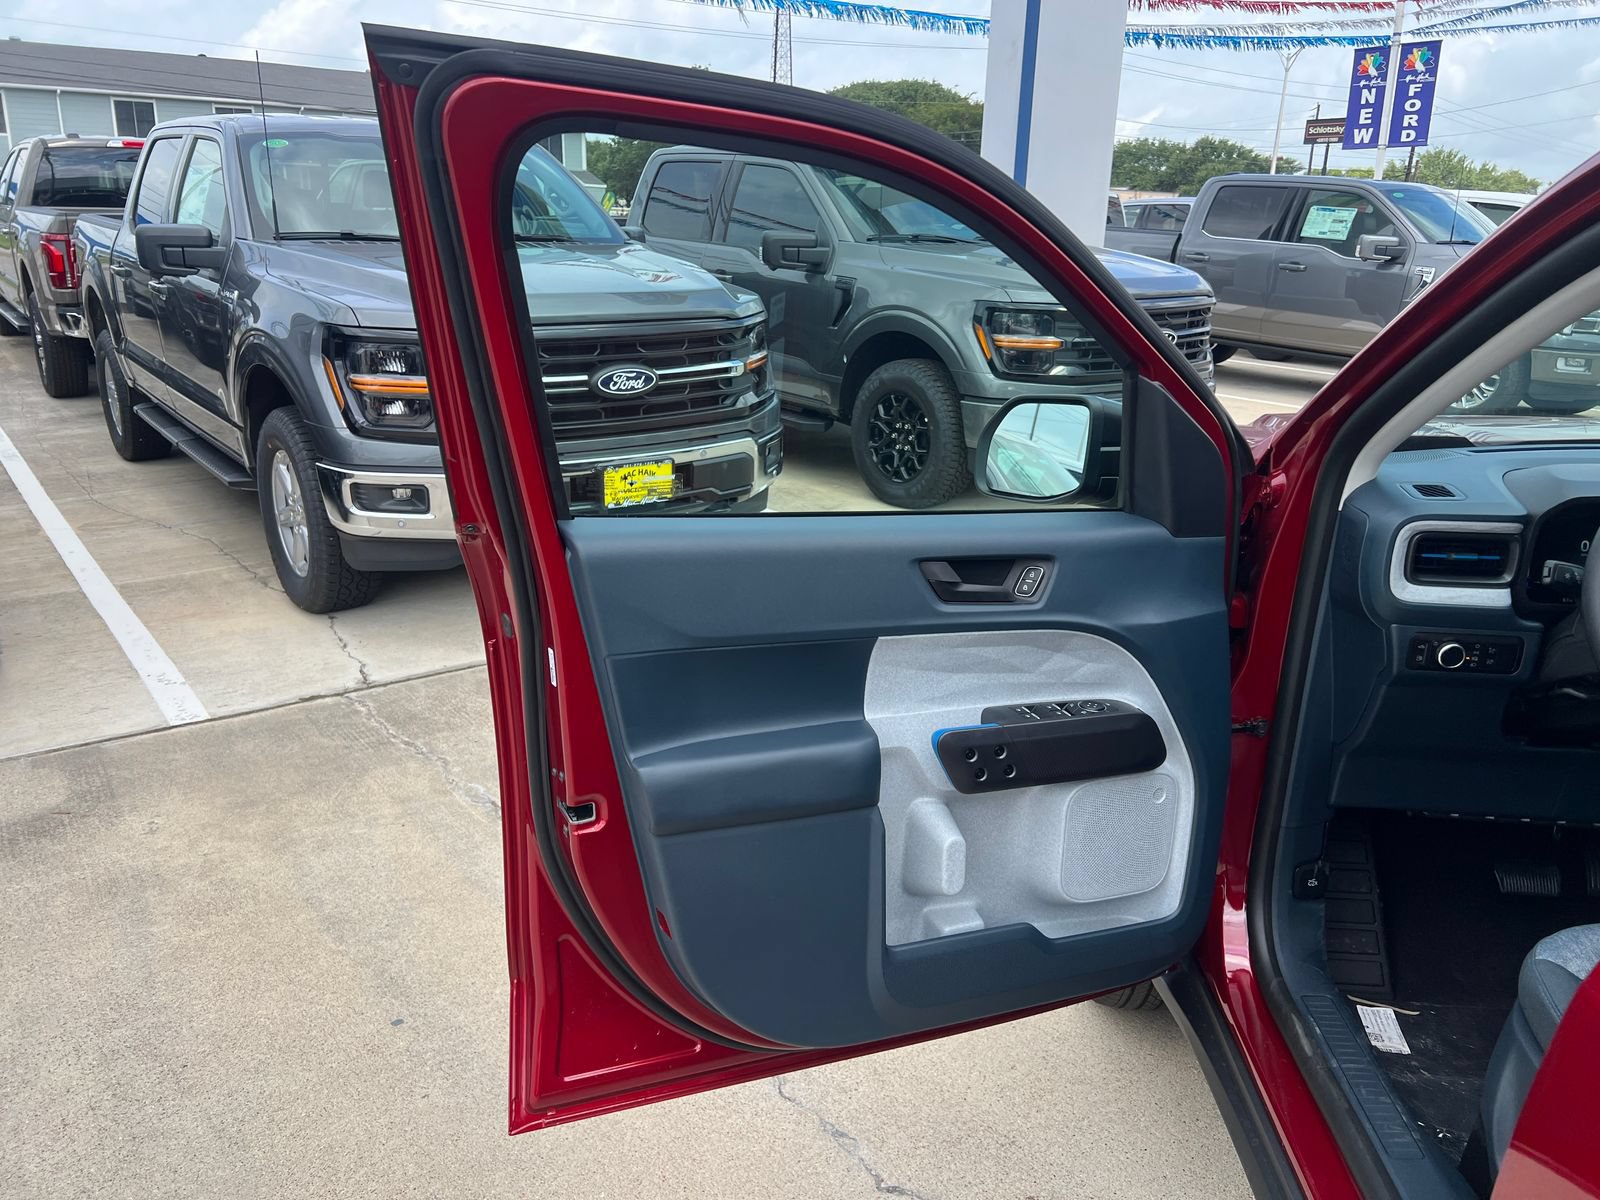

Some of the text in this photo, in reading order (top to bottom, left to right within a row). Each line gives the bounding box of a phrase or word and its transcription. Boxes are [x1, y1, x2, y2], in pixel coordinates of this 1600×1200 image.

[1308, 125, 1346, 134] Schlotzsky
[1353, 87, 1377, 144] NEW
[1400, 83, 1423, 142] FORD
[610, 372, 645, 390] Ford
